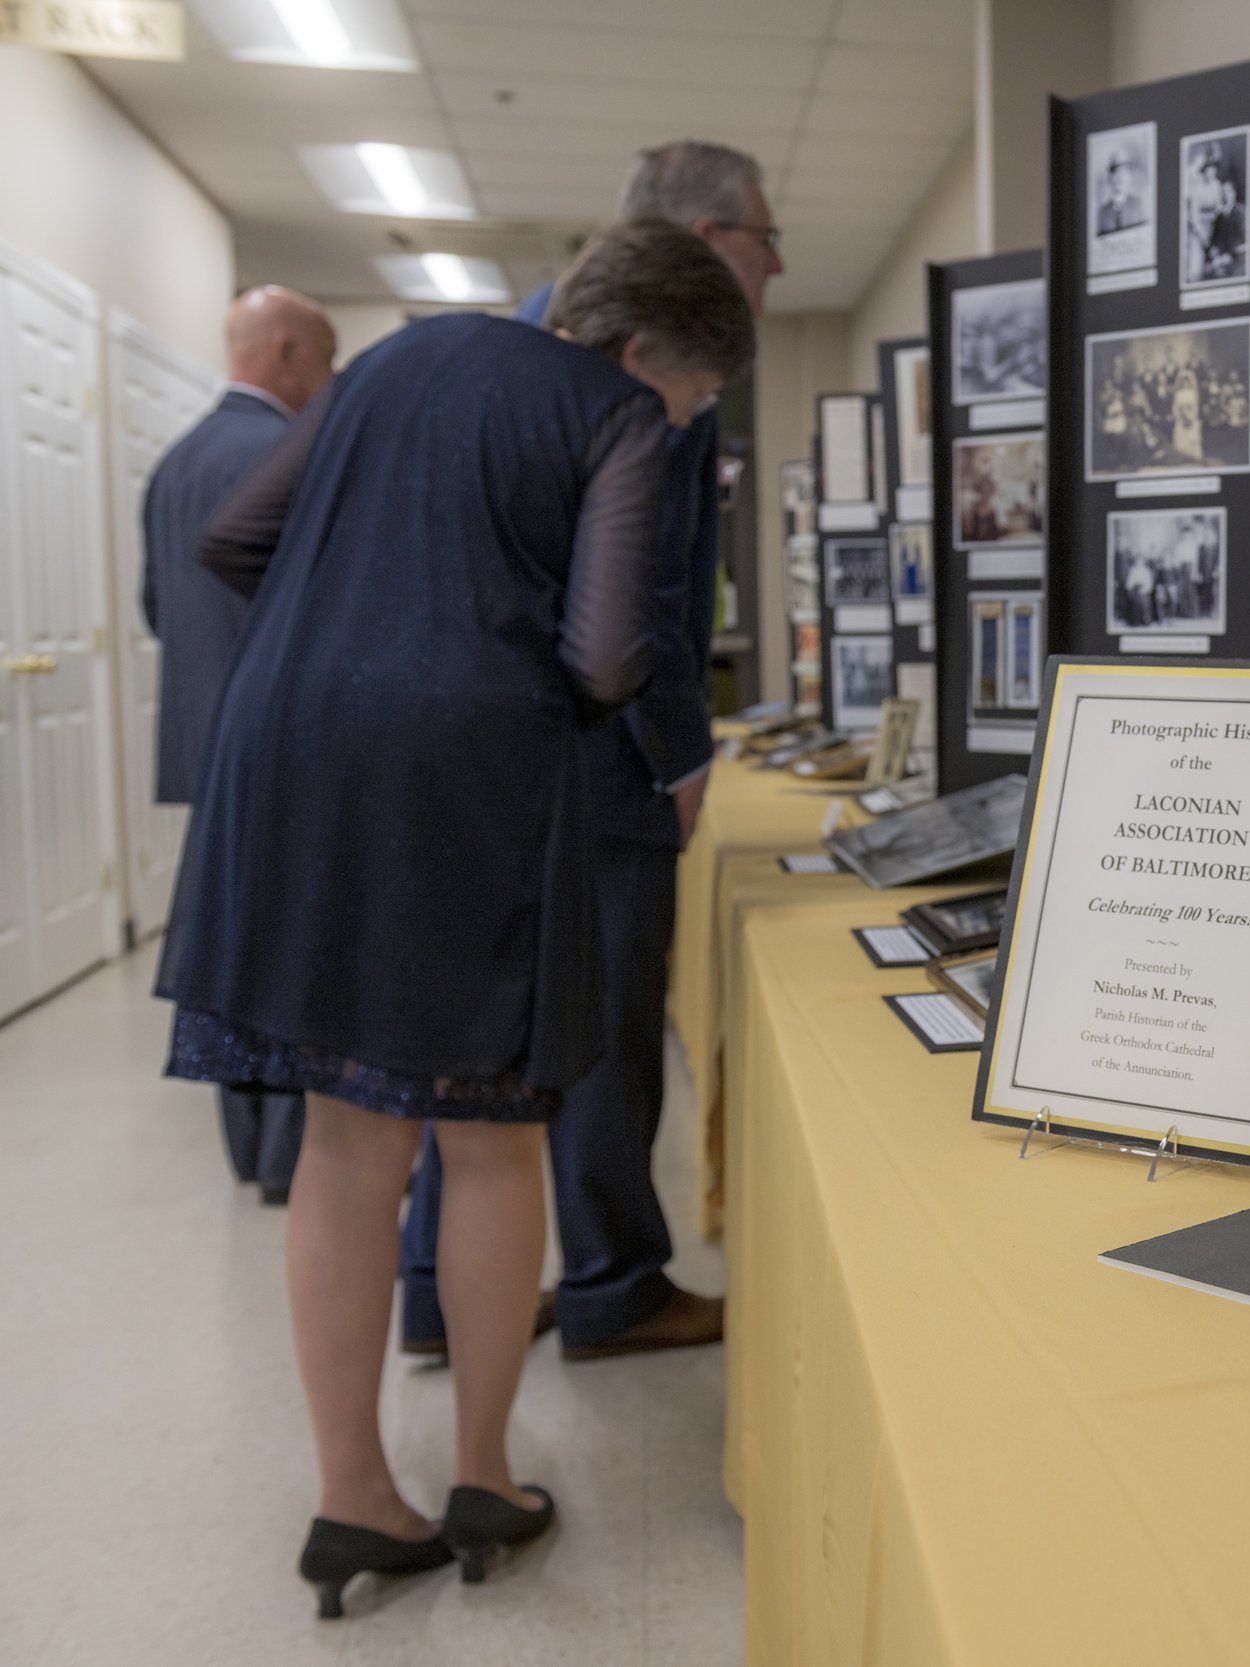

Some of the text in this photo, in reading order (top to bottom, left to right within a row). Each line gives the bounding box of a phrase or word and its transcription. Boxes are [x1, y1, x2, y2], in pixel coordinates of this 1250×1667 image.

[1110, 719, 1218, 742] Photographic
[1169, 754, 1212, 770] of the
[1134, 793, 1241, 815] LACONIAN
[1114, 822, 1248, 846] ASSOCIATION
[1100, 854, 1127, 870] OF
[1087, 897, 1173, 923] Celebrating
[1175, 905, 1202, 921] 100
[1124, 957, 1193, 980] Presented by
[1092, 979, 1216, 1008] Nicholas M. Prevas,
[1094, 1007, 1207, 1032] Parish Historian of the
[1080, 1029, 1215, 1058] Greek Orthodox Cathedral
[1091, 1056, 1193, 1080] of the Annunciation.
